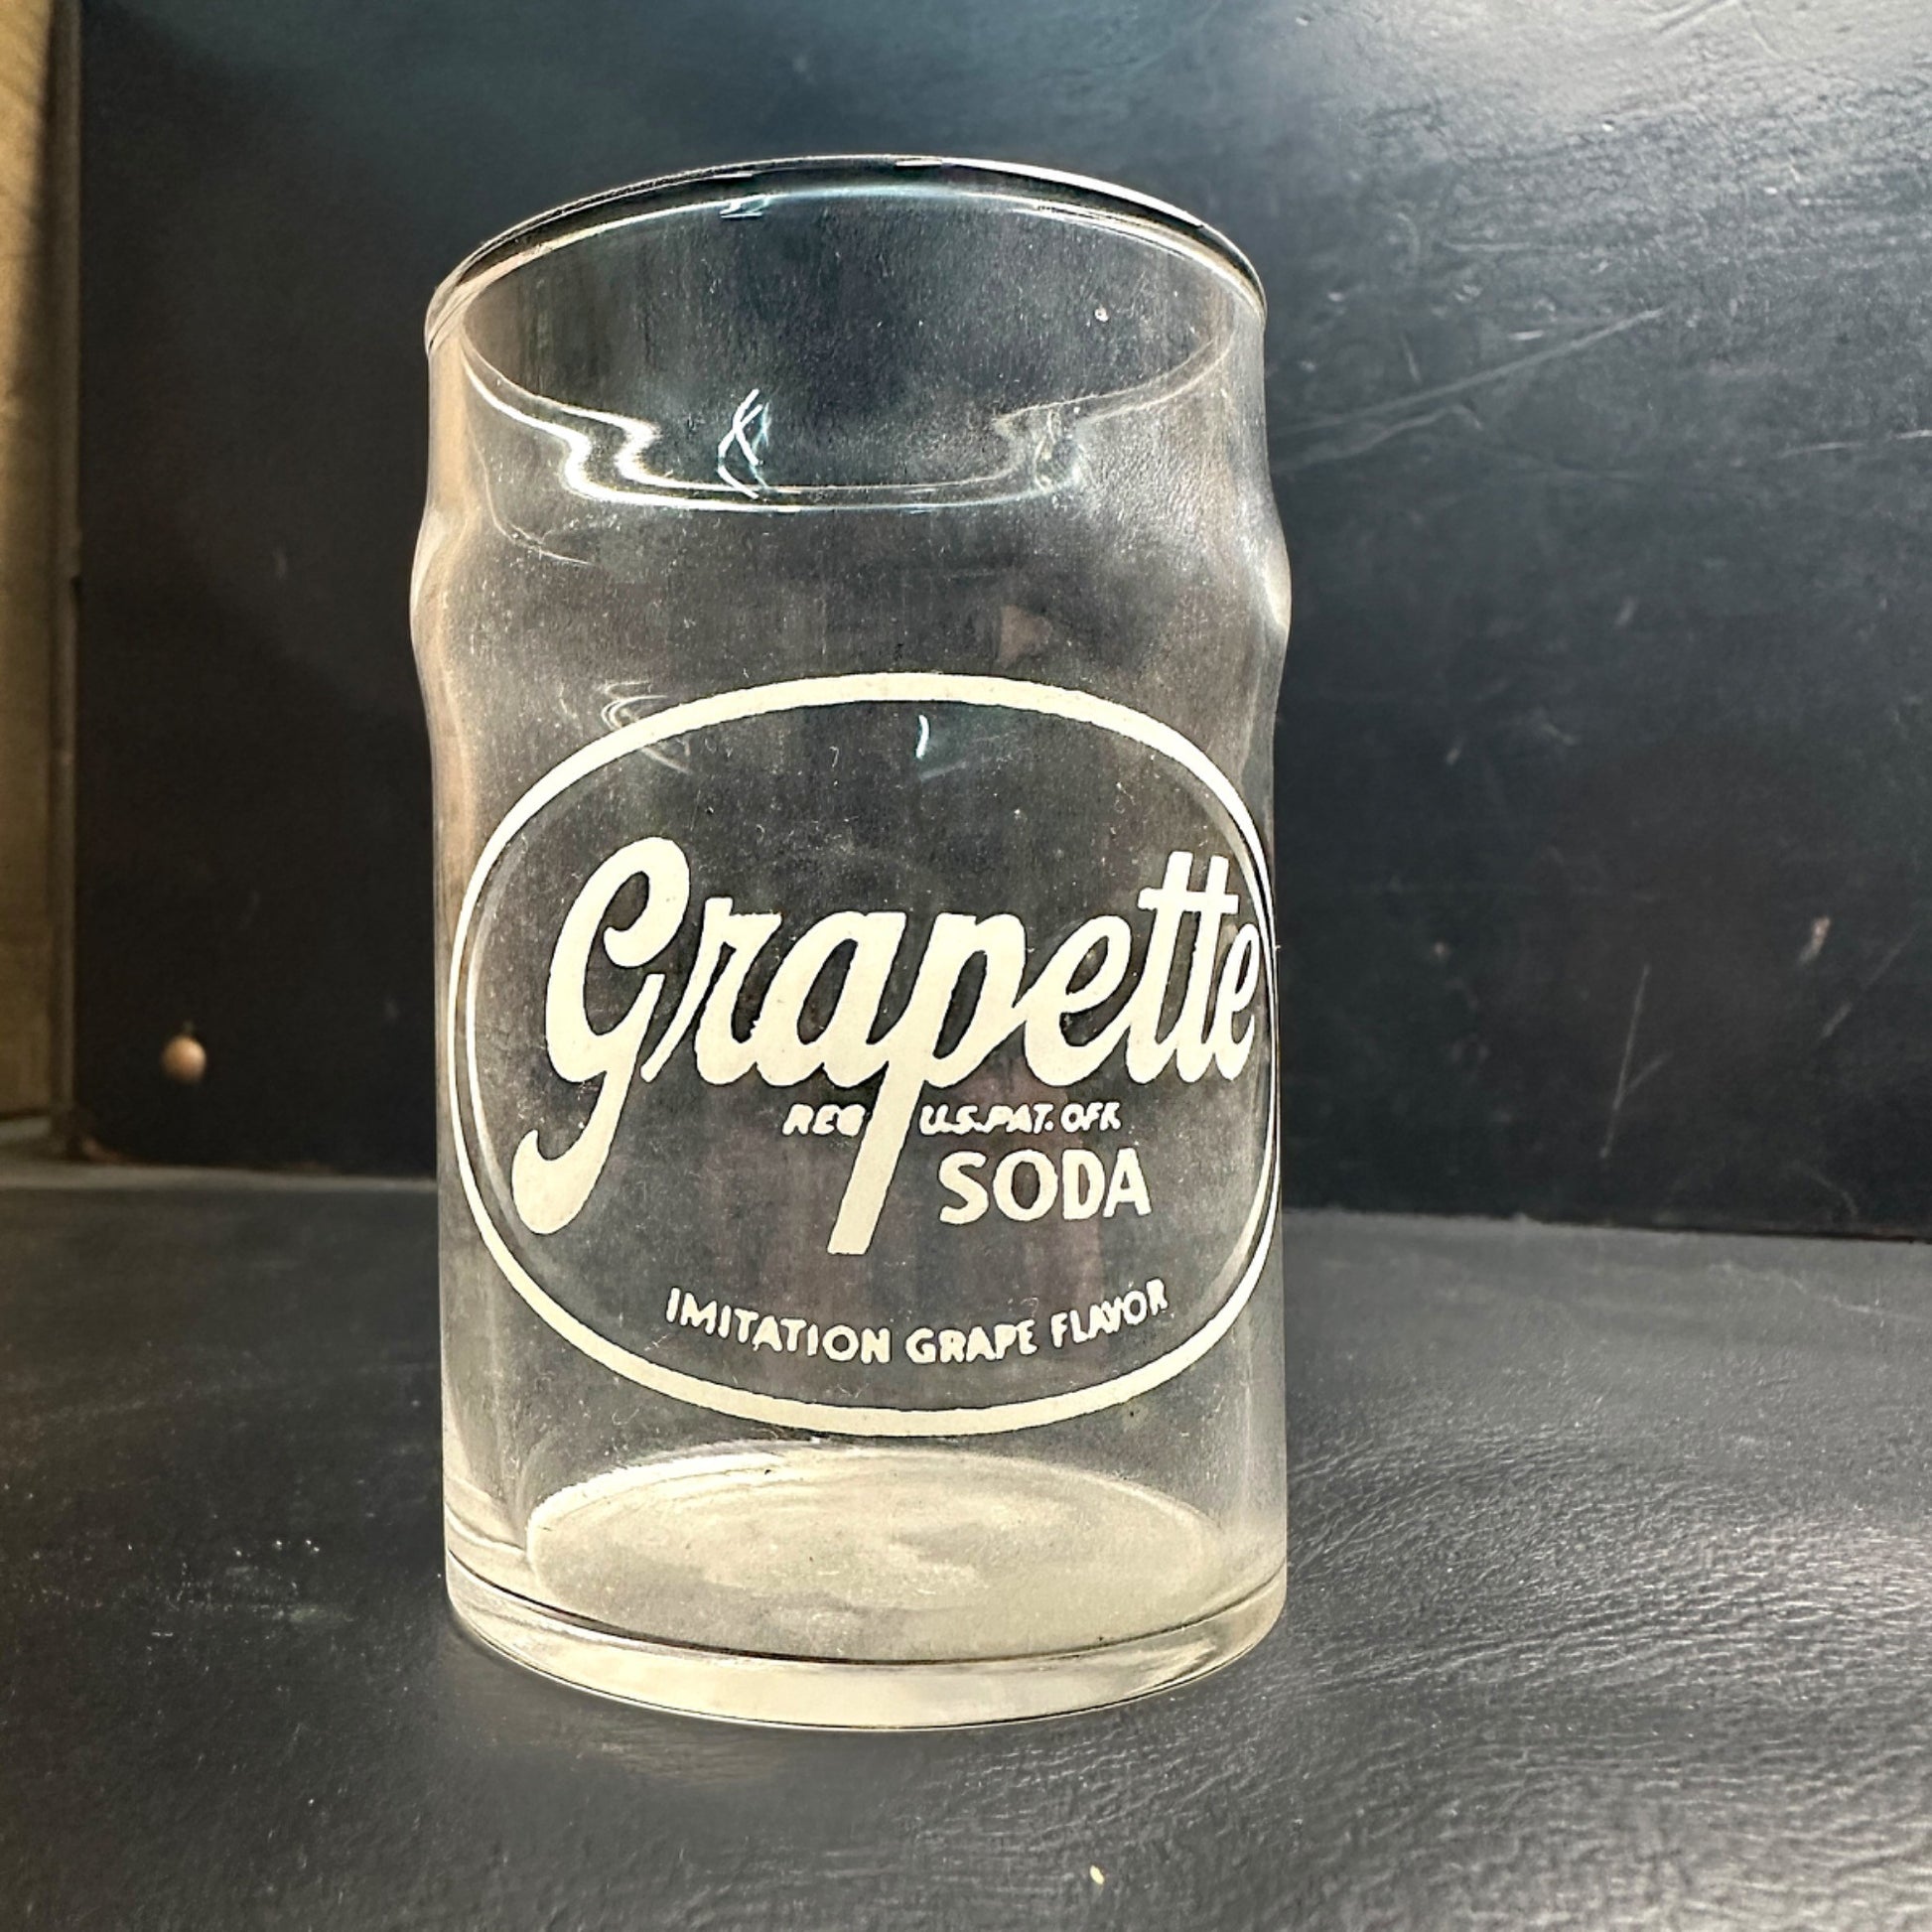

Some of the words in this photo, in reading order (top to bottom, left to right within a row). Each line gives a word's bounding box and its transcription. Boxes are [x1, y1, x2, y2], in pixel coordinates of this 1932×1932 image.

[511, 837, 1260, 1255] Grapette
[938, 1147, 1152, 1225] SODA
[666, 1288, 892, 1364] IMITATION
[905, 1318, 1036, 1362] GRAPE
[1050, 1279, 1169, 1348] FLAVOR
